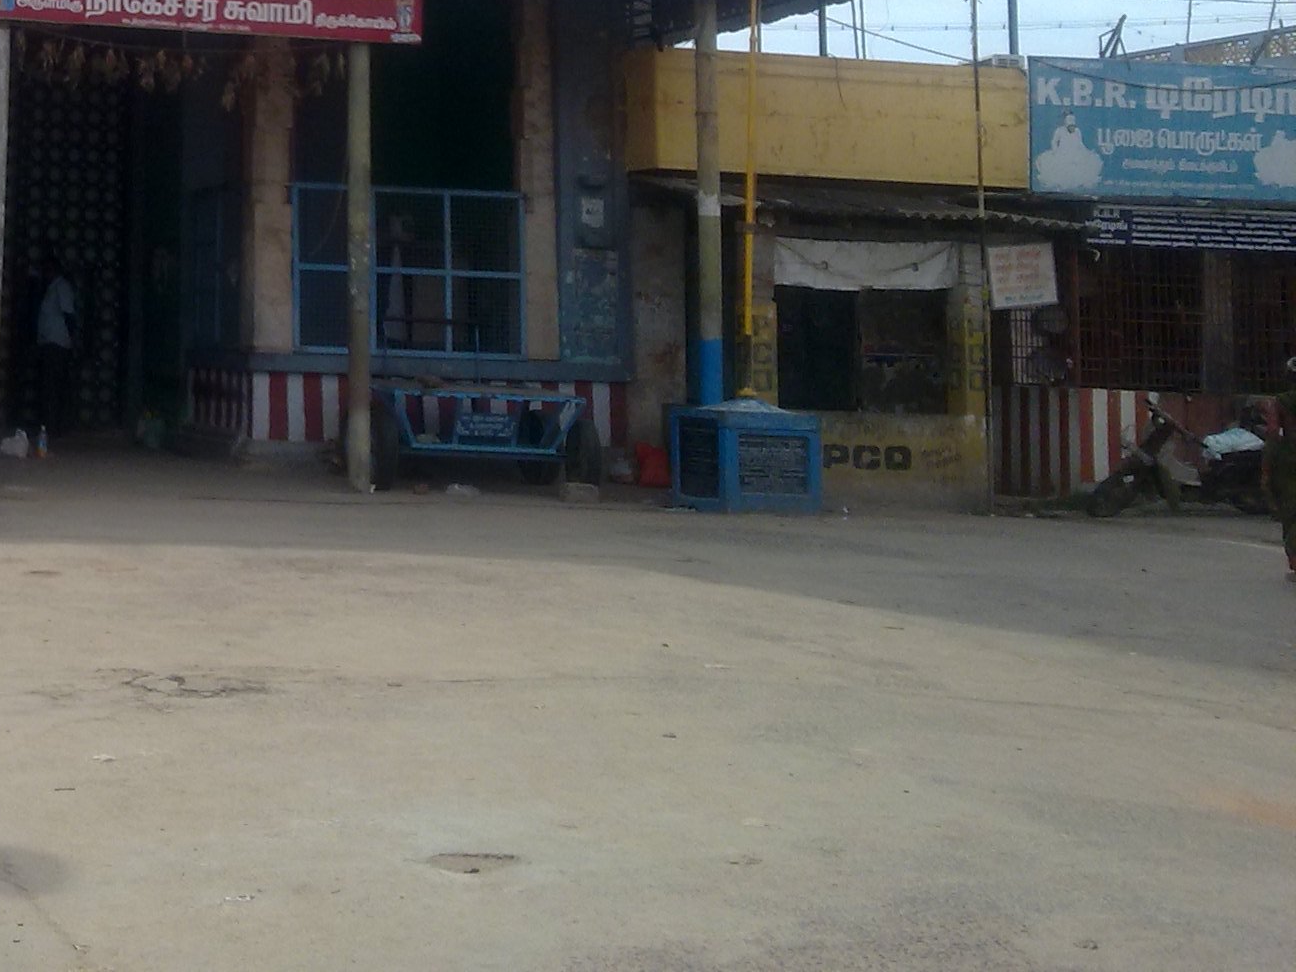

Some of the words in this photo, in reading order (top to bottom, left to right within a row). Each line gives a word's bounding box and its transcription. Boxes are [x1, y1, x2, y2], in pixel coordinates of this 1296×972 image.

[1036, 77, 1136, 109] K.B.R.
[1097, 128, 1154, 155] பூஜை
[1156, 127, 1263, 155] பொருட்கள்
[822, 443, 913, 471] PCO
